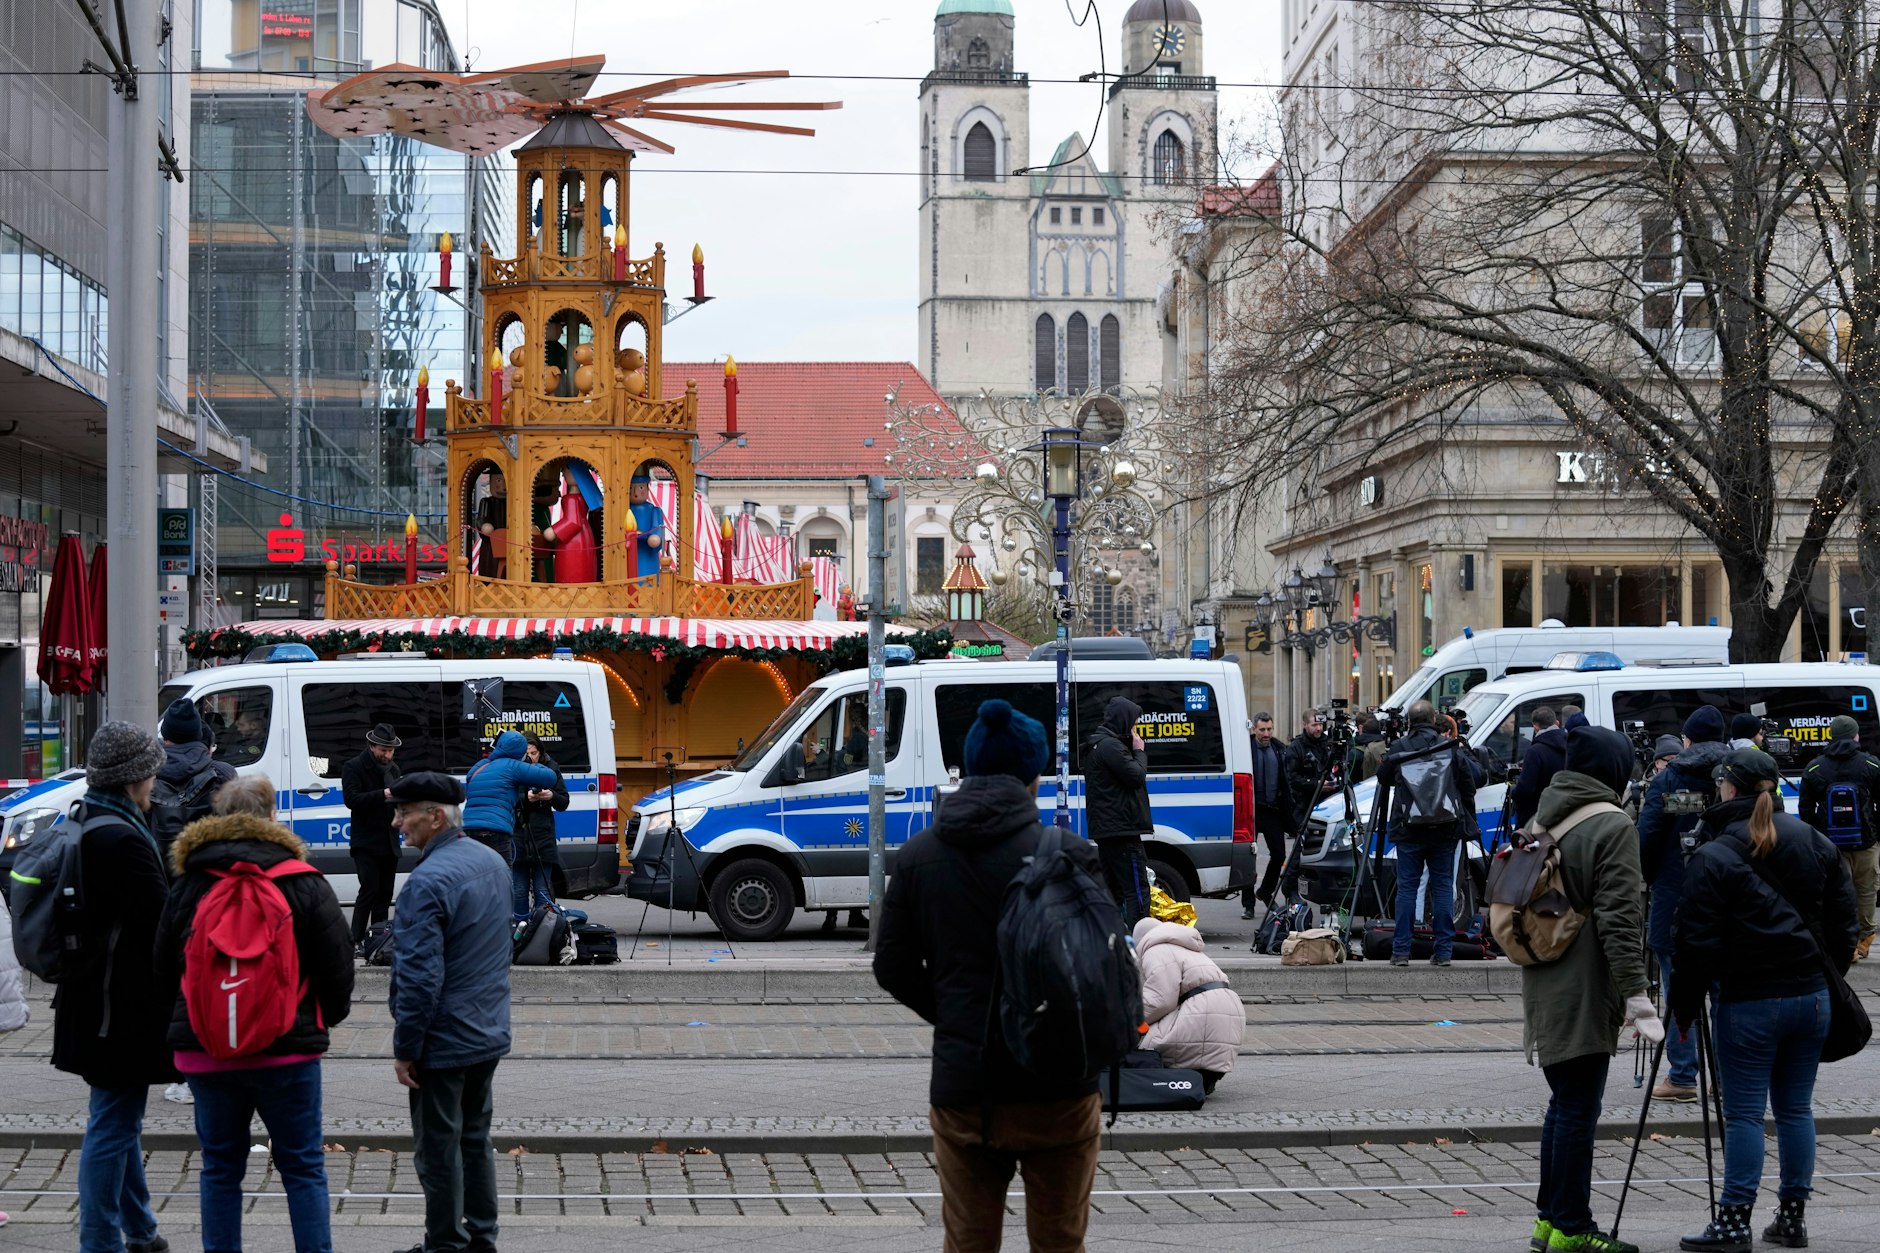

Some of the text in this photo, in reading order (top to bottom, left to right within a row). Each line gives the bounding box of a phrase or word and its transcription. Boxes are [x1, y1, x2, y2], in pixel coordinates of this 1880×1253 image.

[163, 530, 187, 539] Bank
[1137, 712, 1187, 723] RDÄCHTIG
[1789, 715, 1834, 728] VERDÄCH
[1157, 722, 1195, 738] JOBS!
